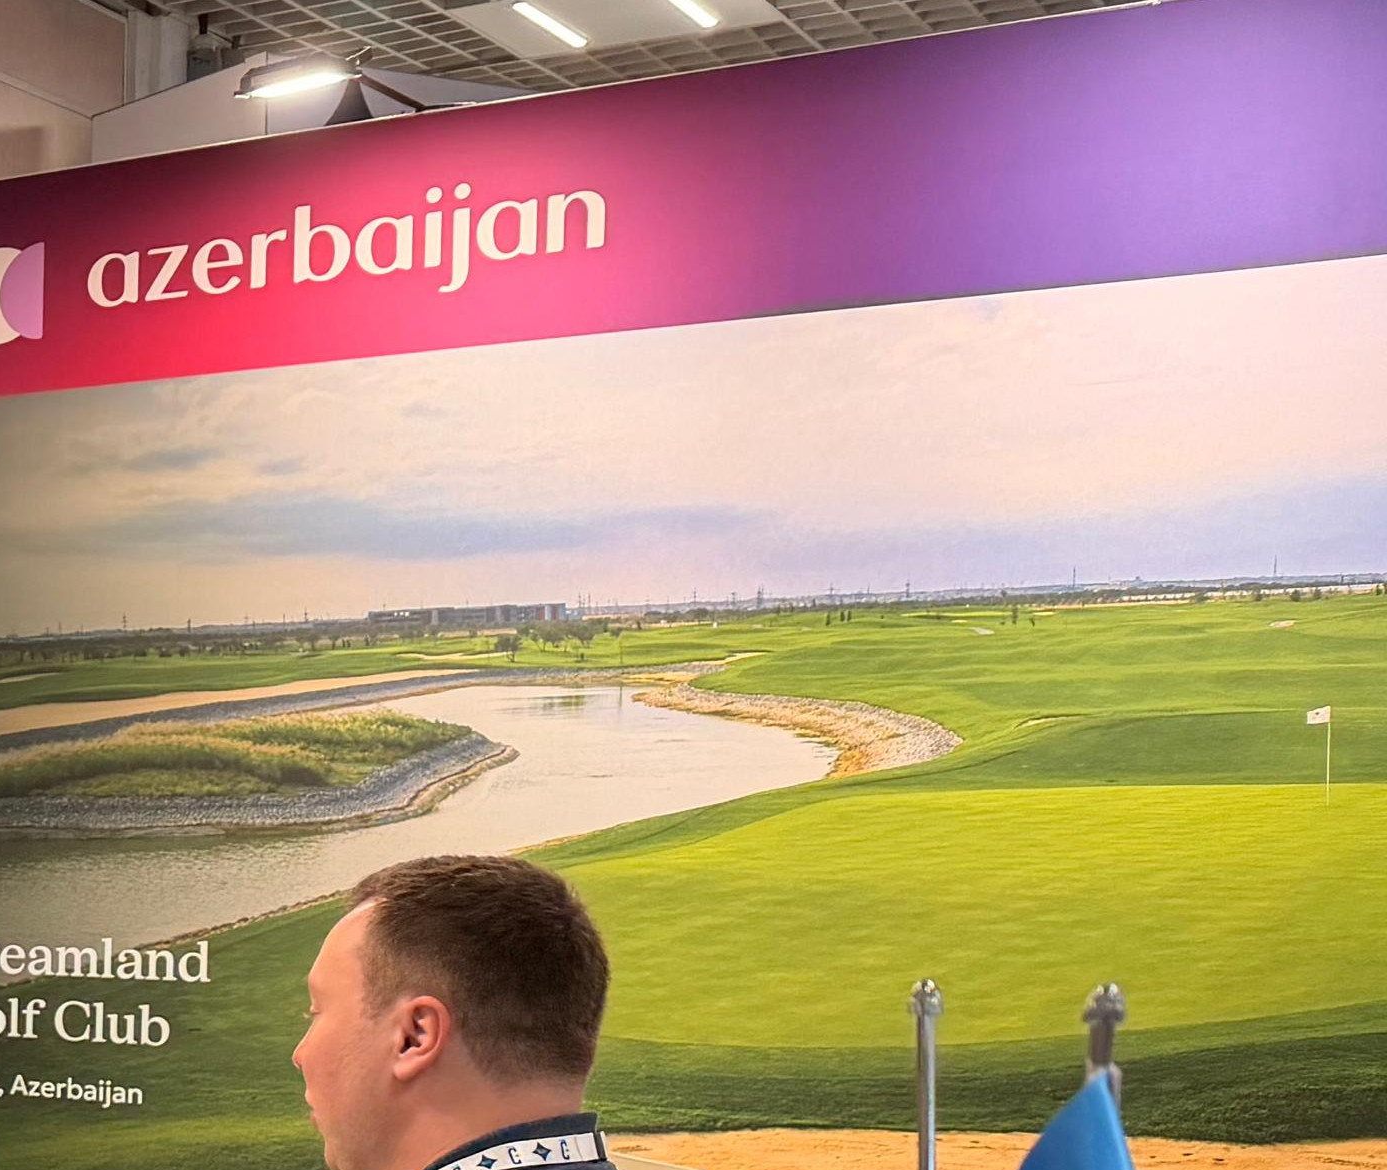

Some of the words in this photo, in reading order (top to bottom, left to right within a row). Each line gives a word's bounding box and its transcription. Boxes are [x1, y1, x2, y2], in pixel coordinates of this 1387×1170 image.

[87, 183, 606, 308] azerbaijan
[54, 1000, 171, 1047] Club
[10, 1074, 143, 1109] Azerbaijan
